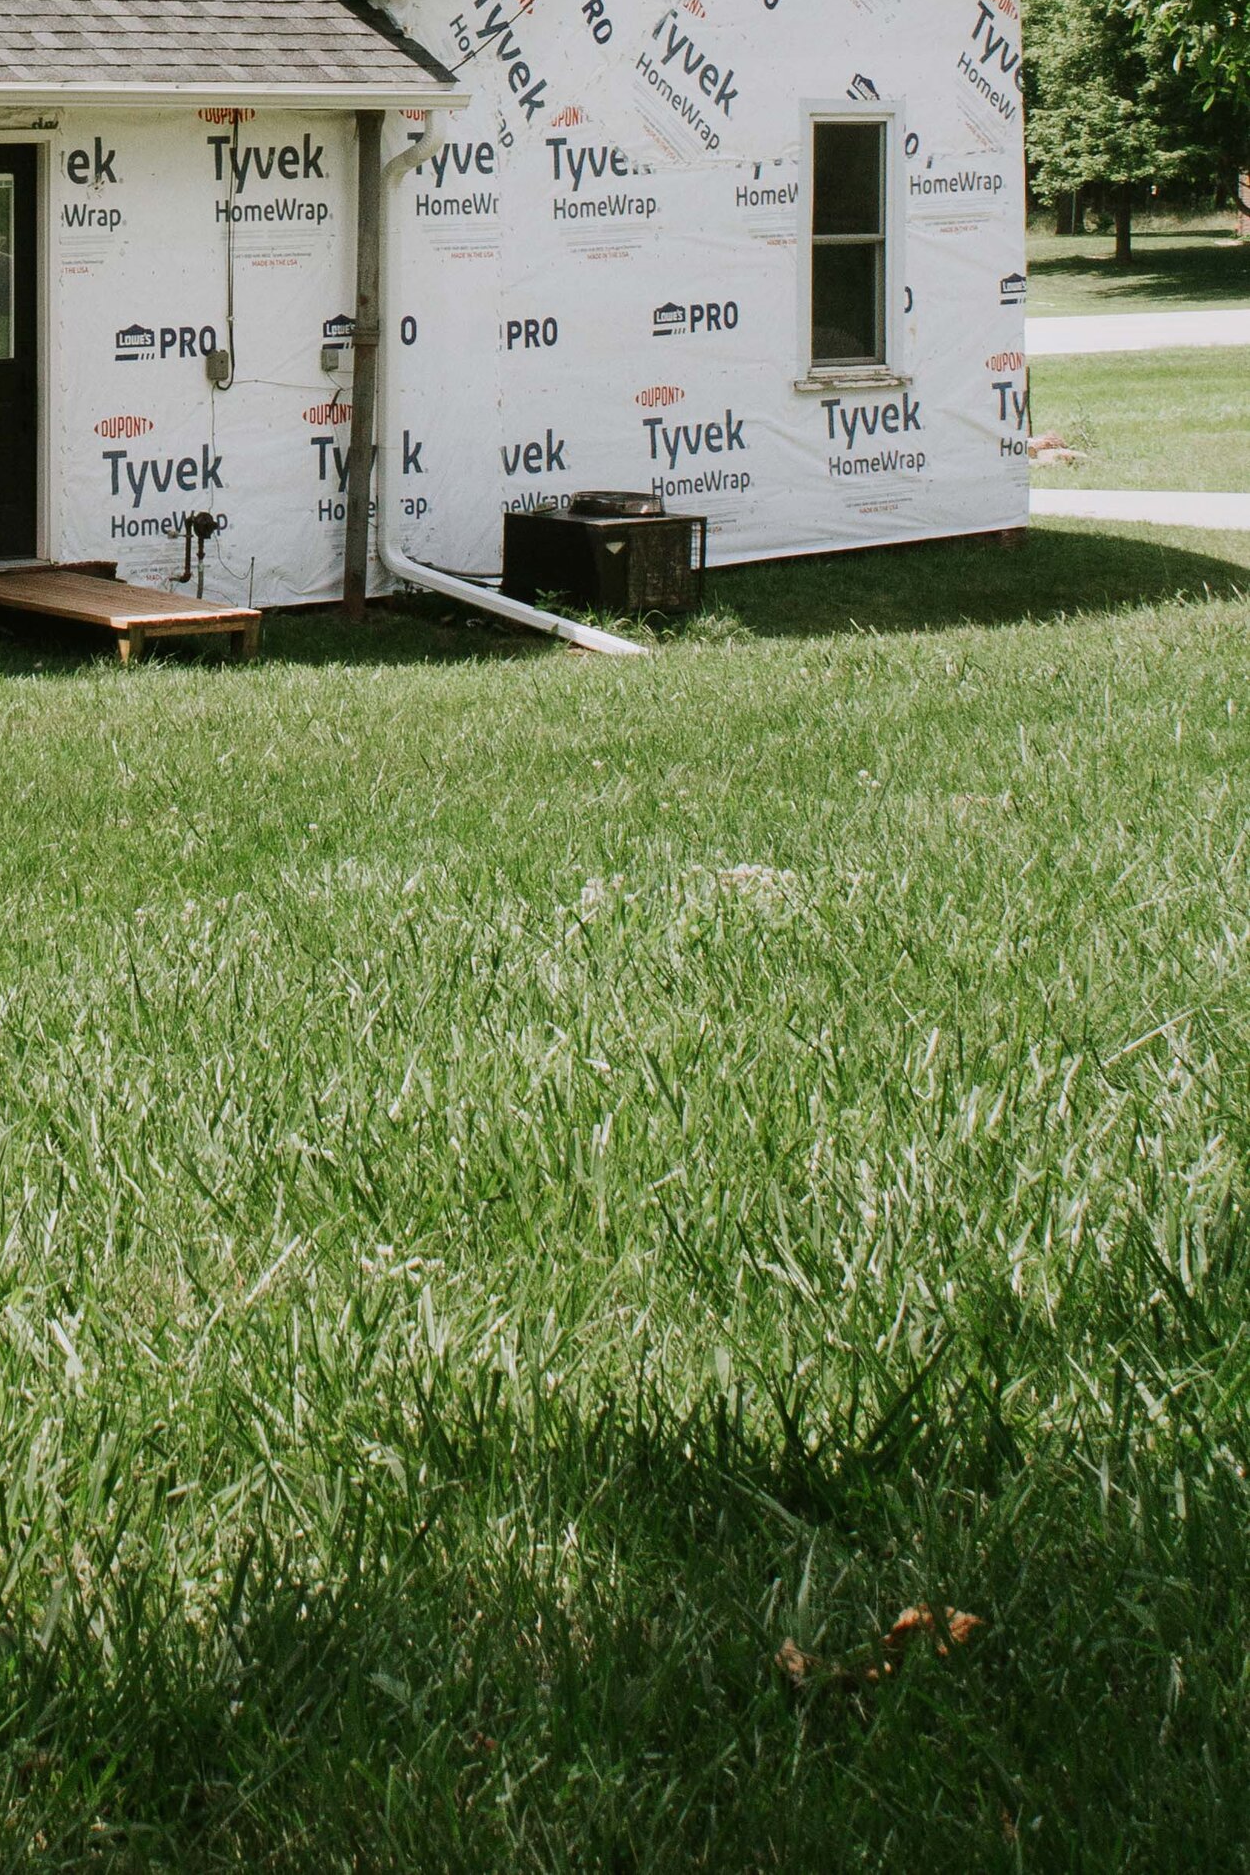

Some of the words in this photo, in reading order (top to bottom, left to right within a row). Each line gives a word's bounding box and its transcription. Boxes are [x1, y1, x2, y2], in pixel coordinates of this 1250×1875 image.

[651, 8, 738, 117] Tyvek
[636, 52, 719, 150] HomeWrap
[207, 133, 324, 194] Tyvek
[910, 171, 1002, 195] HomeWrap
[215, 198, 328, 225] HomeWrap
[554, 194, 656, 220] HomeWrap
[690, 301, 738, 333] PRO
[118, 333, 152, 346] LOWE'S
[160, 325, 216, 359] PRO
[507, 317, 558, 350] PRO
[641, 387, 680, 408] DUPONT
[101, 416, 147, 438] DUPONT
[820, 392, 921, 450] Tyvek
[642, 409, 746, 470] Tyvek
[102, 443, 224, 508] Tyvek
[829, 450, 926, 476] HomeWrap
[652, 469, 751, 499] HomeWrap
[111, 510, 228, 539] HomeWp
